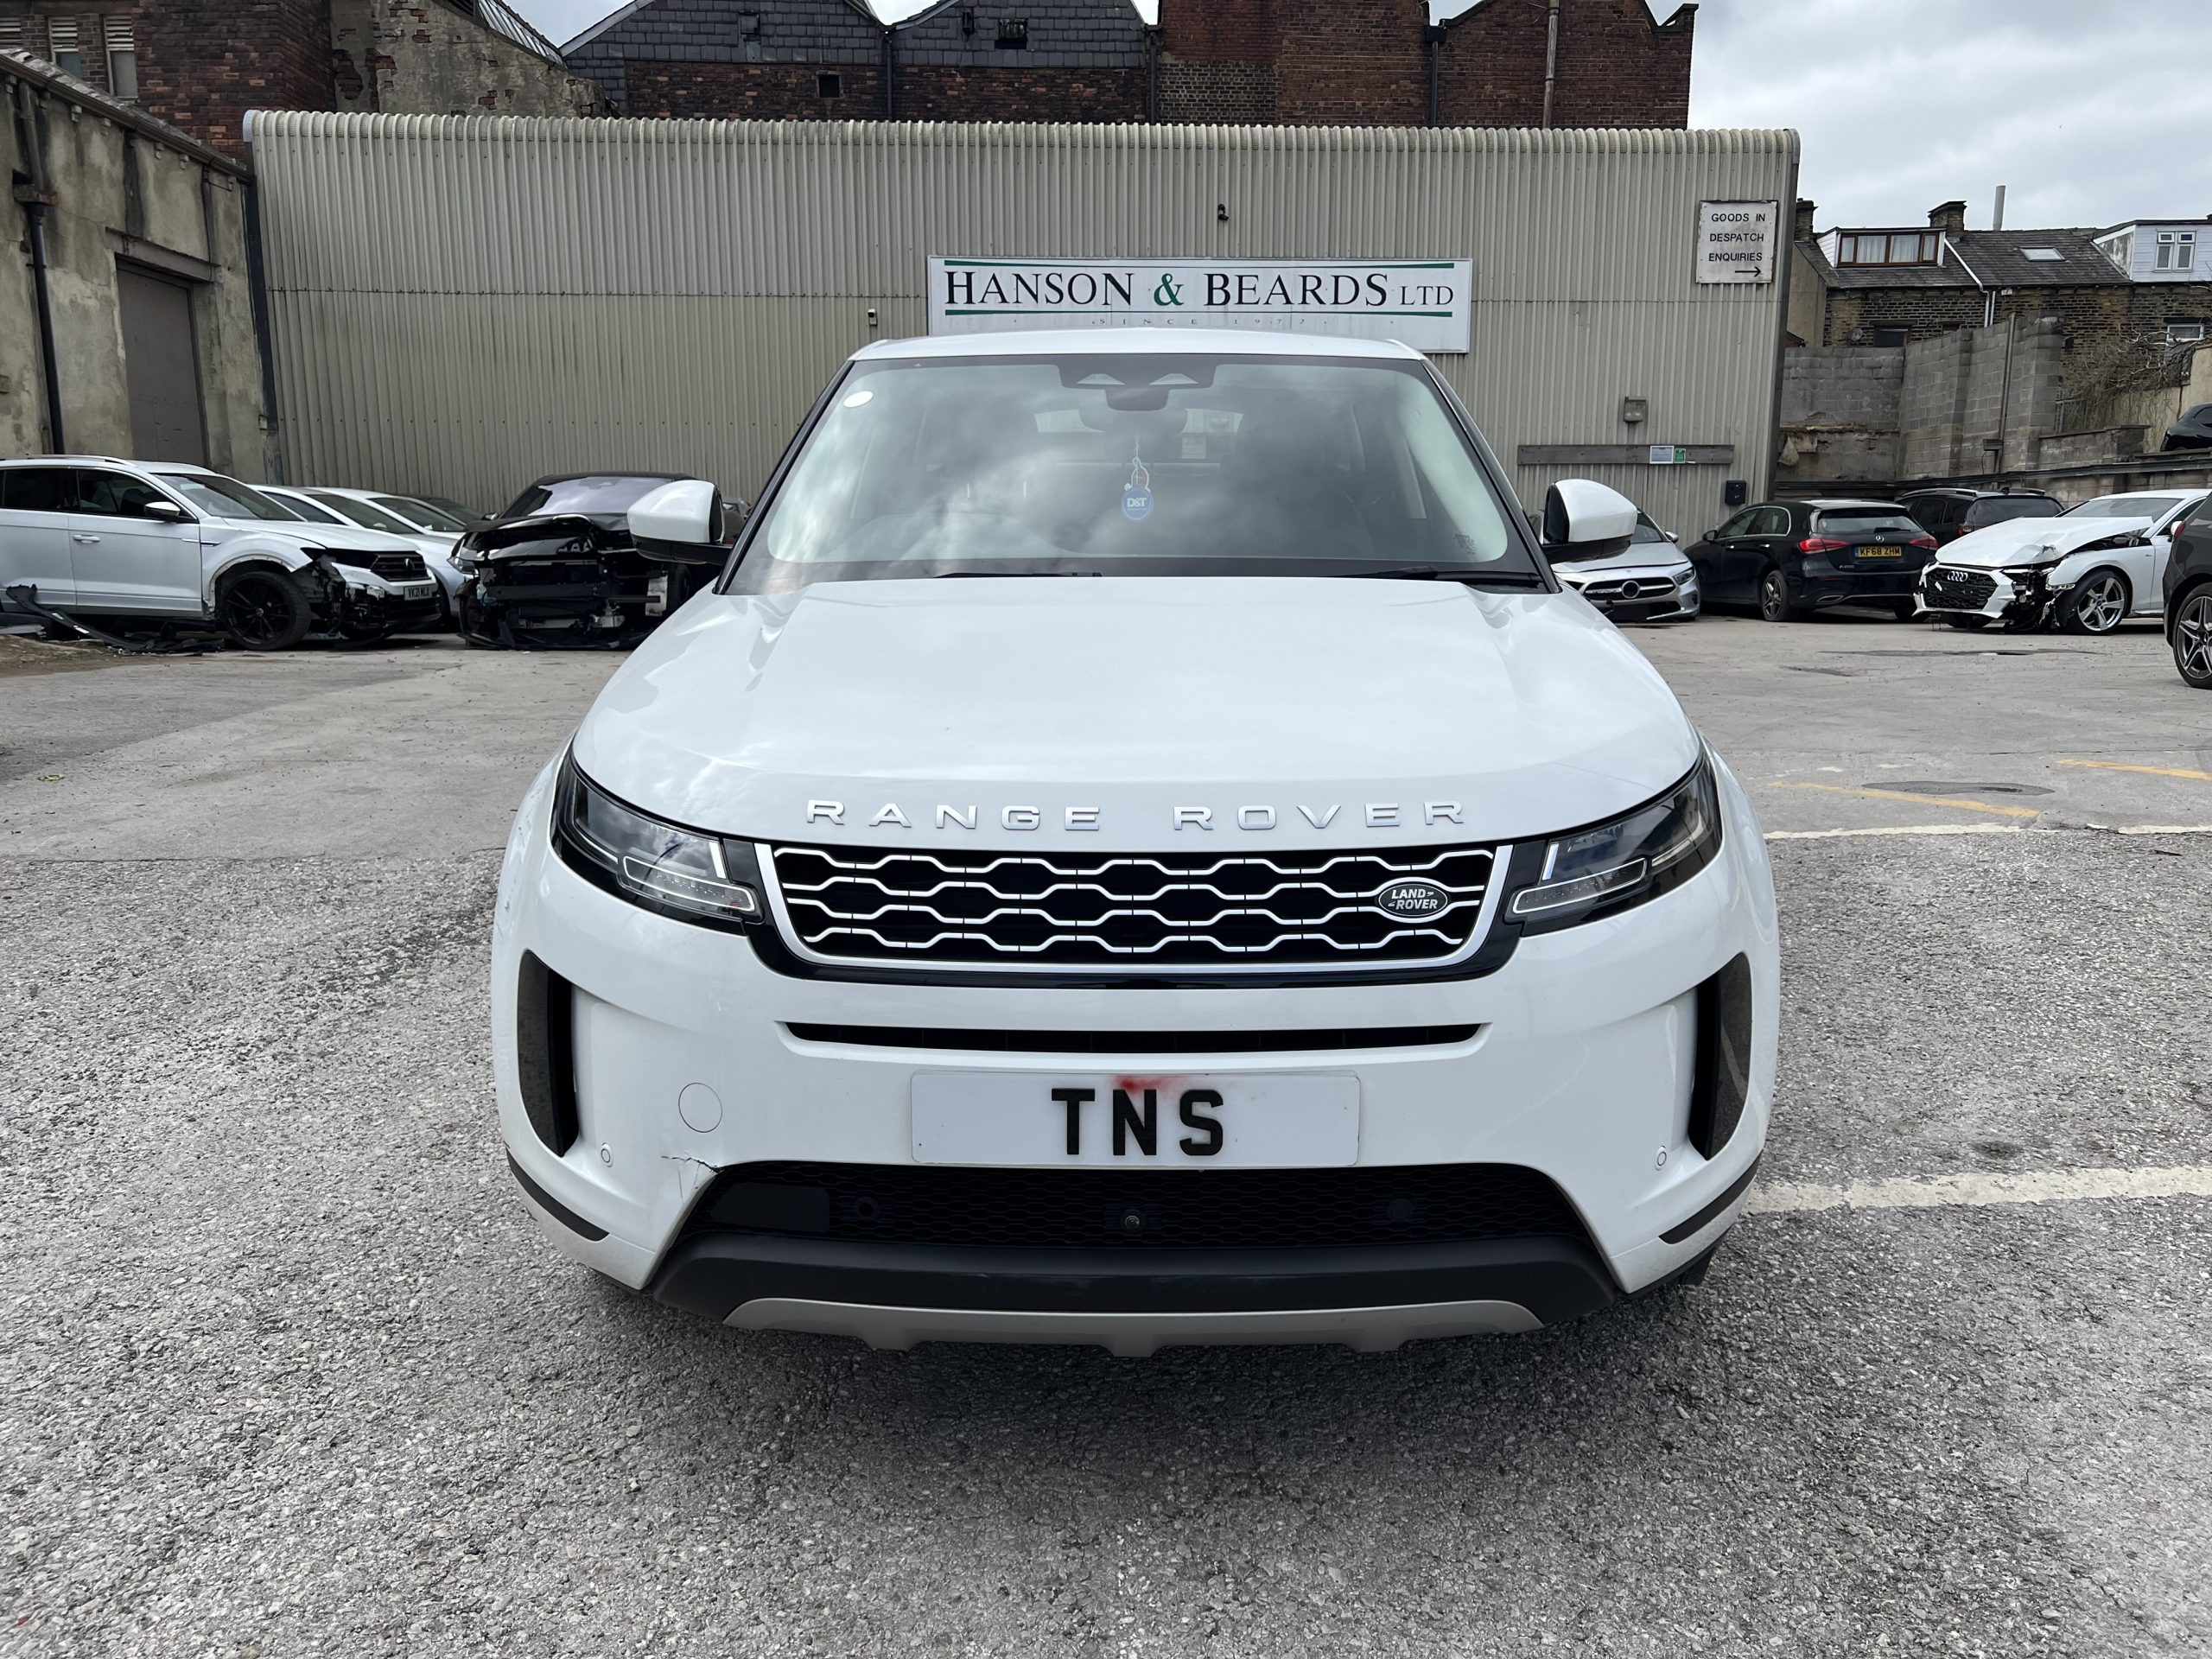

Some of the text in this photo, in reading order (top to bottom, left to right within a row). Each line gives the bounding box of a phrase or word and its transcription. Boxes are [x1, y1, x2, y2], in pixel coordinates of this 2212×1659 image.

[1711, 213, 1765, 222] GOODS IN
[1709, 233, 1764, 242] DESPATCH
[1708, 252, 1763, 262] ENQUIRIES
[944, 270, 1454, 306] HANSON & BEARDS LTD
[1127, 497, 1147, 507] D&T
[1859, 547, 1882, 556] KF68
[807, 799, 1465, 830] RANGE ROVER
[1391, 888, 1427, 899] LAND
[1395, 899, 1438, 910] ROVER
[1051, 1088, 1224, 1156] TNS
